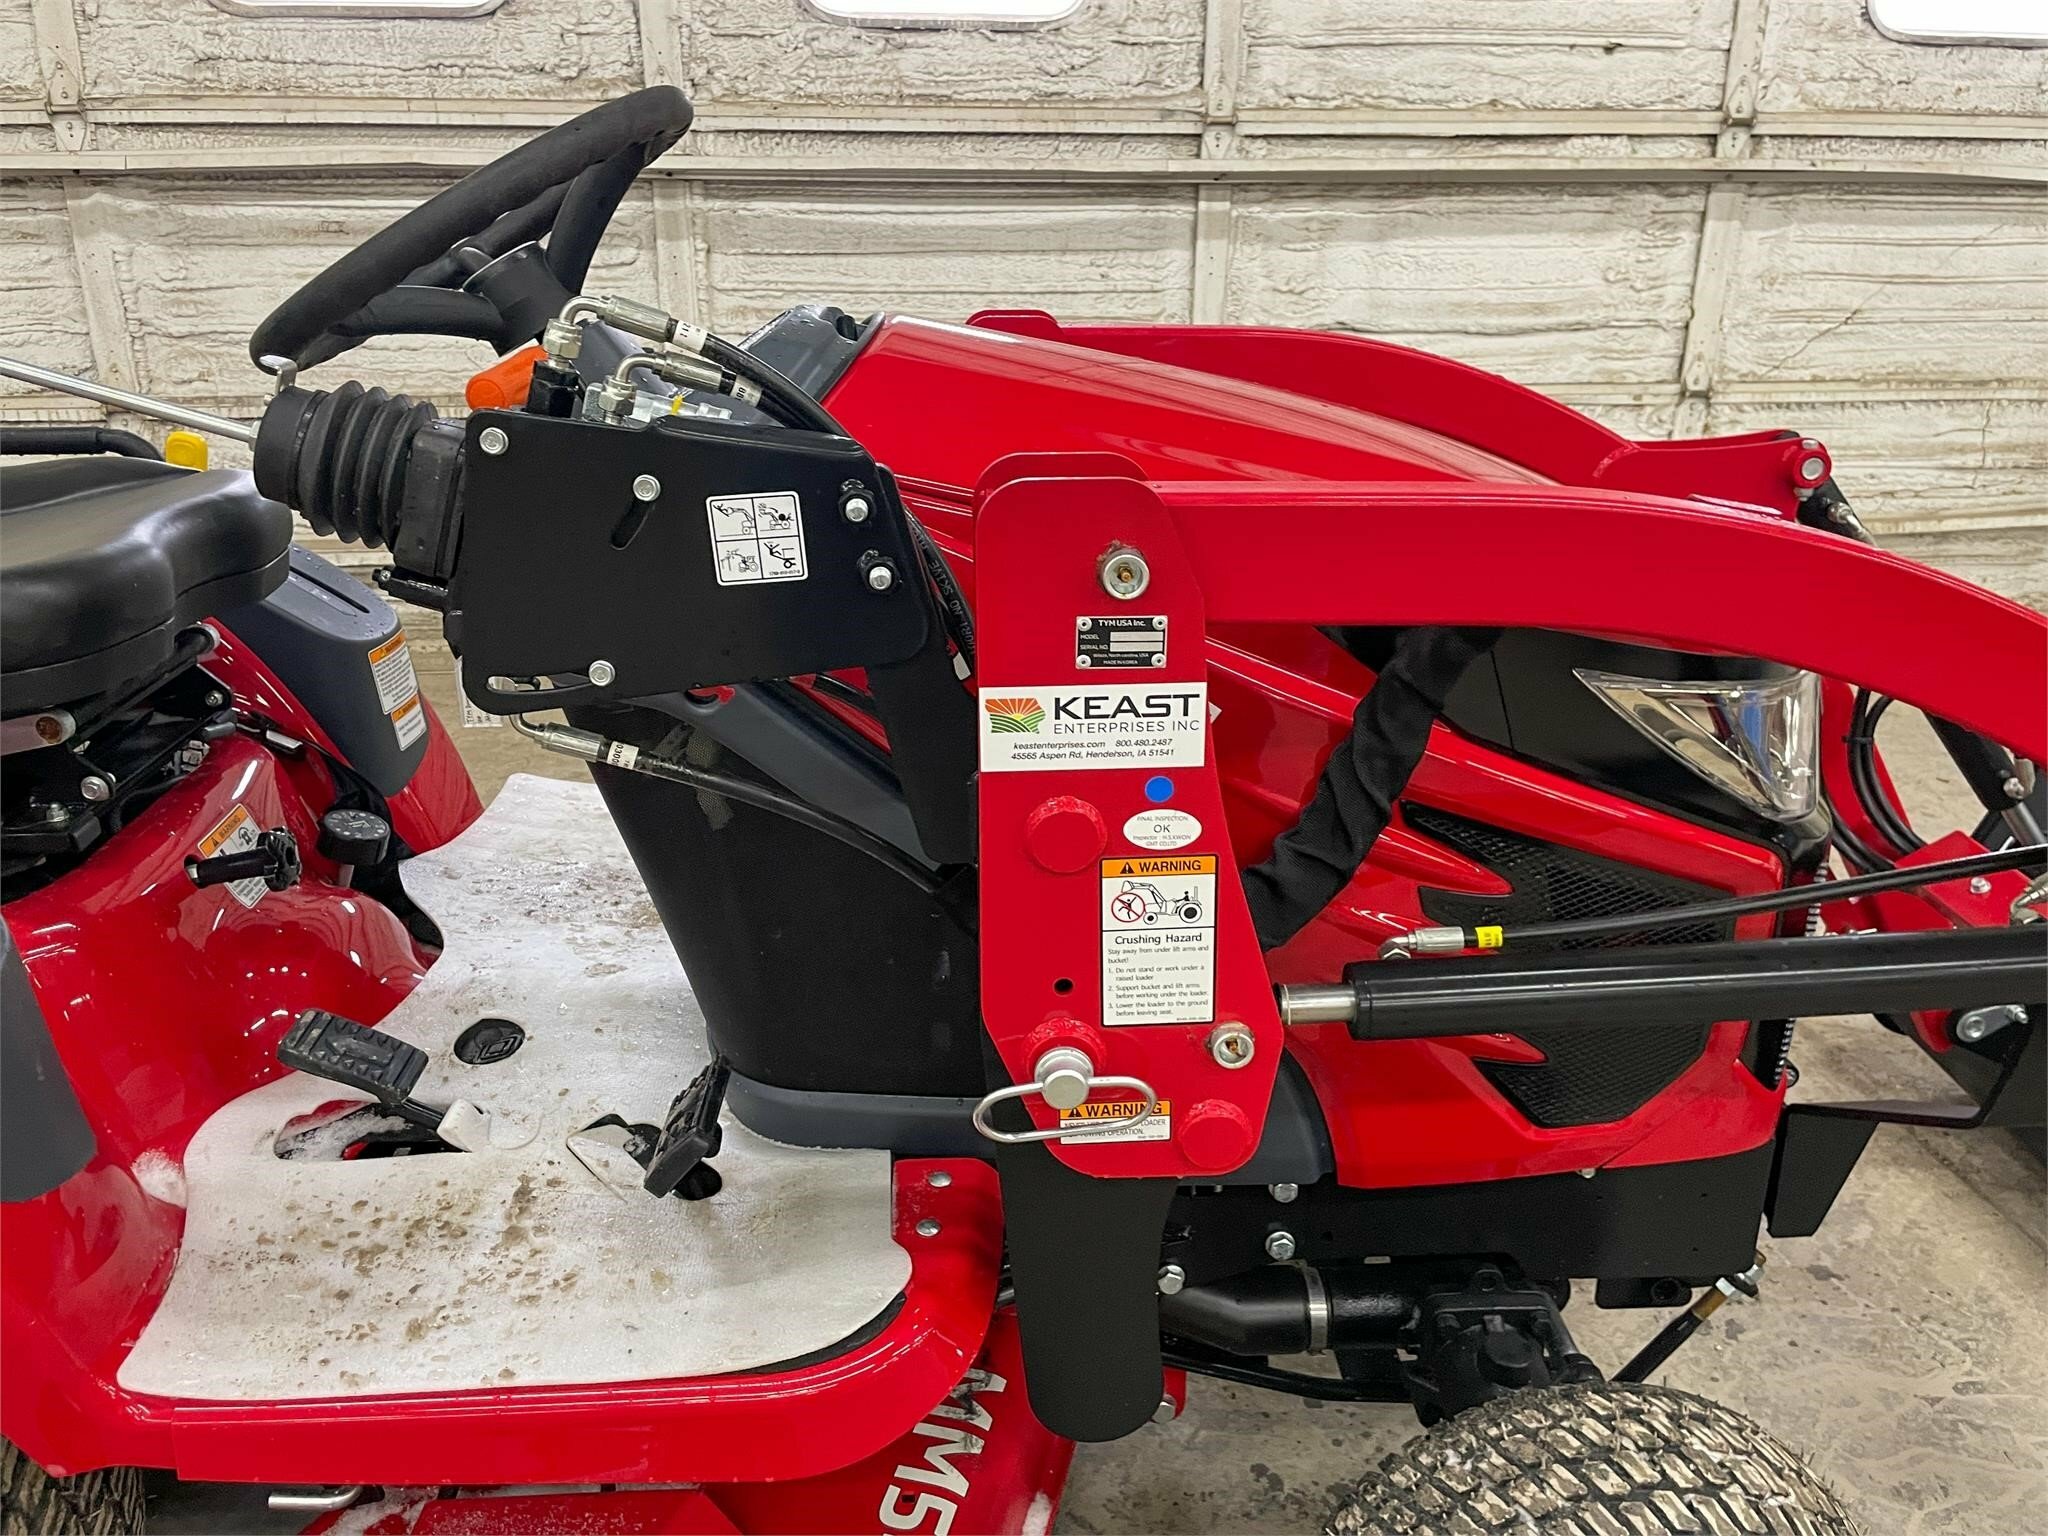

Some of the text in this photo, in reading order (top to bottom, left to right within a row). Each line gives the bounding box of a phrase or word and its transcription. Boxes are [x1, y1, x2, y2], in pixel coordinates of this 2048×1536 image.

[1054, 694, 1200, 720] KEAST
[1054, 720, 1200, 734] ENTERPRISES INC
[1013, 738, 1173, 750] keastenterprises.com 800.480.2487
[1011, 752, 1037, 760] 45565
[1039, 752, 1067, 760] Aspen
[1086, 750, 1135, 758] Henderson,
[1153, 824, 1171, 833] OK
[1138, 860, 1202, 872] WARNING
[1115, 932, 1202, 945] Crushing Hazard
[1140, 1118, 1166, 1127] LOADER
[879, 1368, 1008, 1536] MM5
